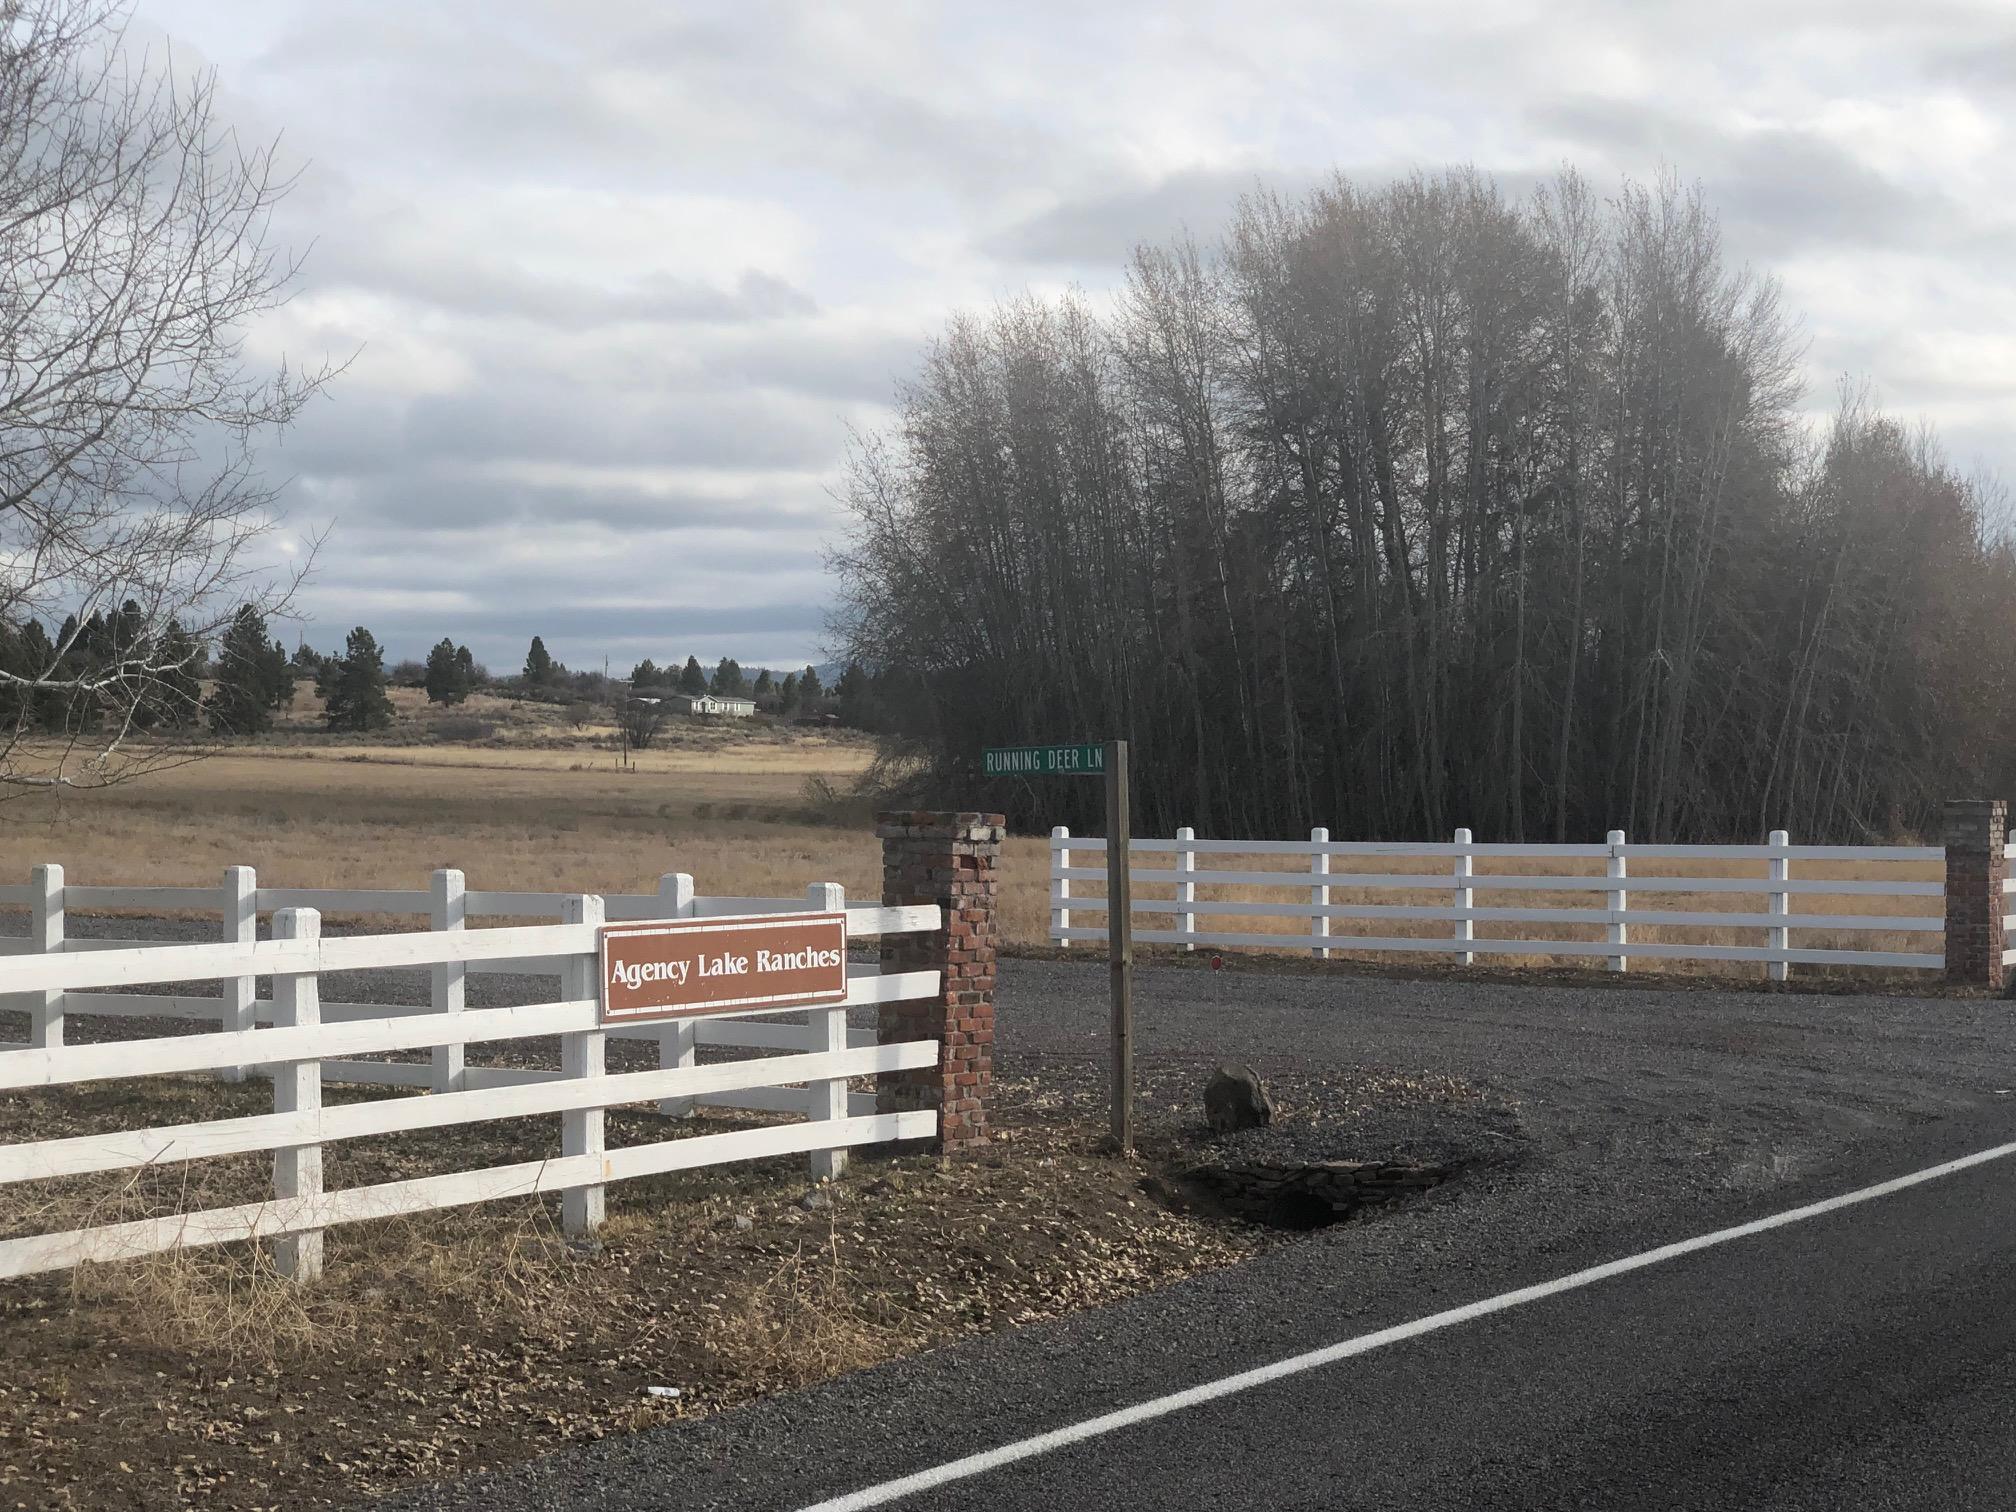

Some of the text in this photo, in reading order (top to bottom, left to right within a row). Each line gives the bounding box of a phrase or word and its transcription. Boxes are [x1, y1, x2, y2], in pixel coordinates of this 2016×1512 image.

[986, 748, 1103, 772] RUNNING DEER LN
[611, 946, 841, 990] Agency Lake Ranches
